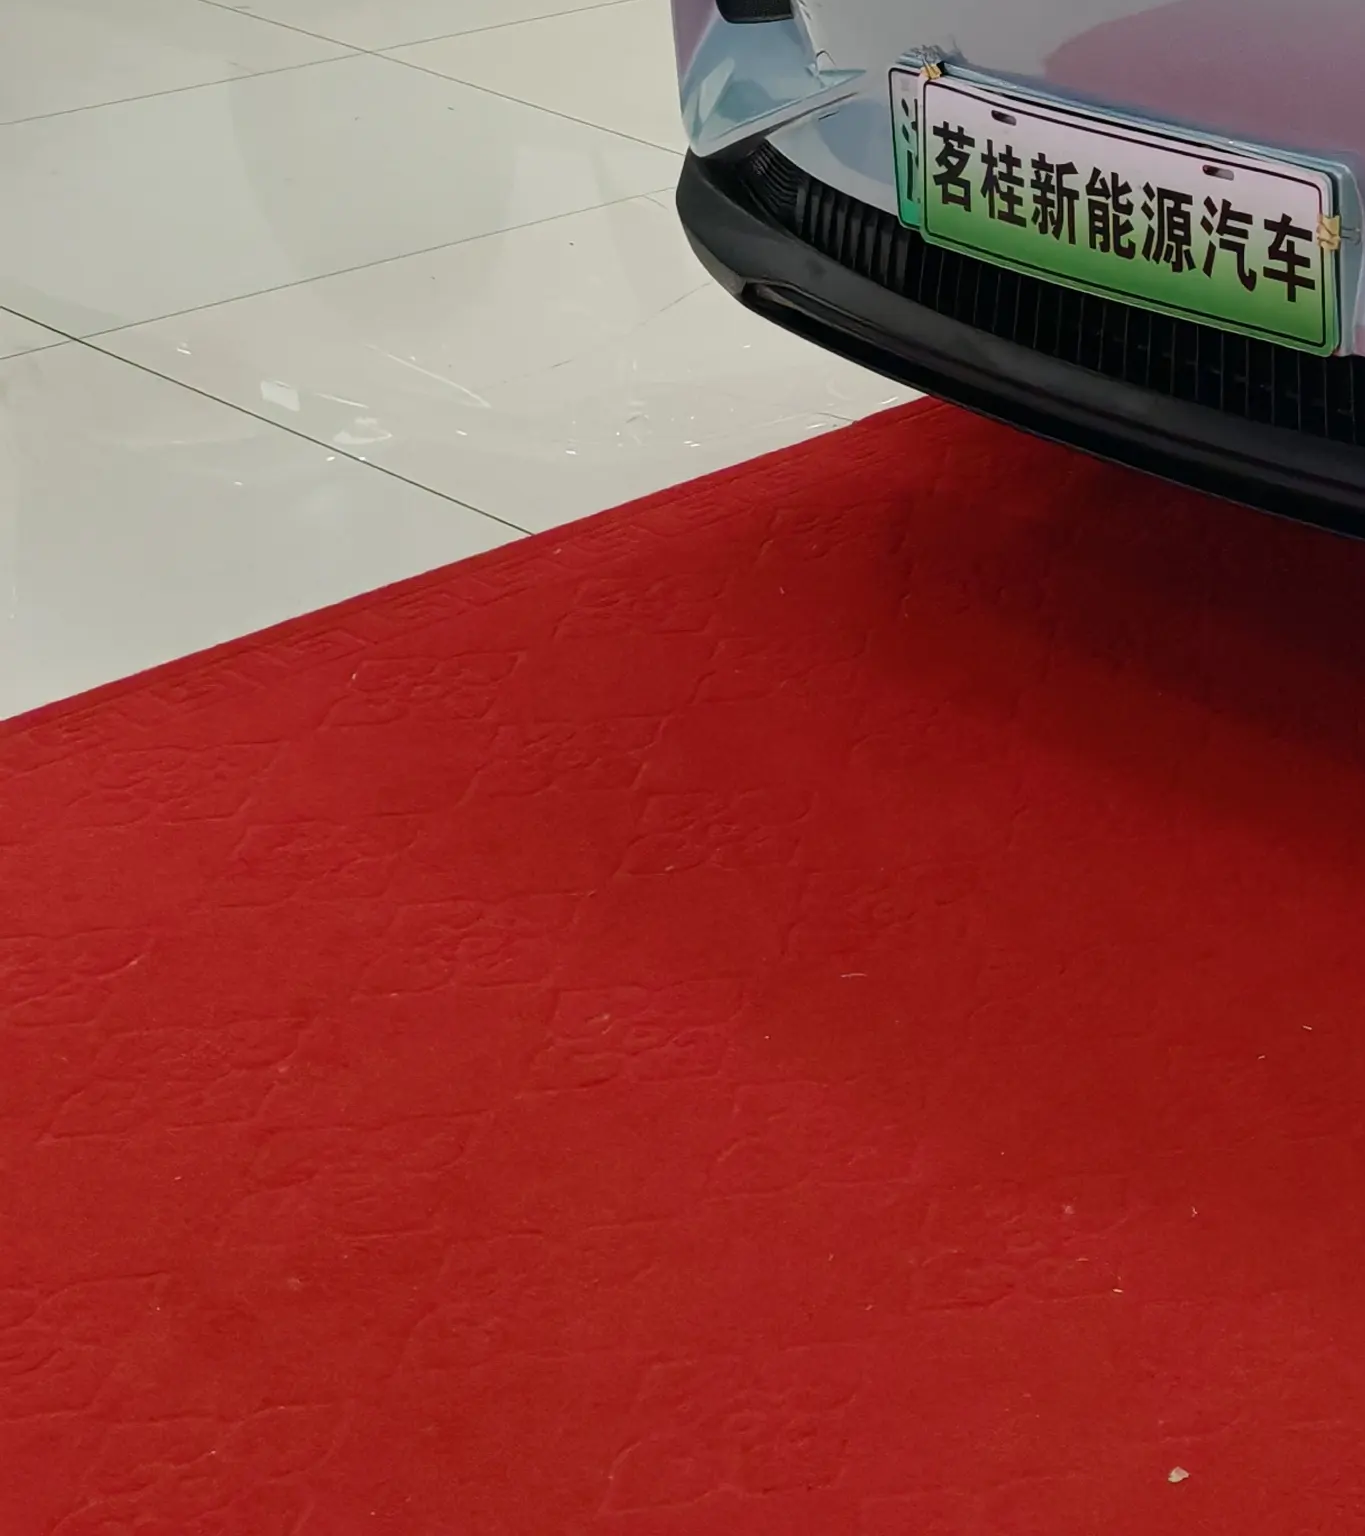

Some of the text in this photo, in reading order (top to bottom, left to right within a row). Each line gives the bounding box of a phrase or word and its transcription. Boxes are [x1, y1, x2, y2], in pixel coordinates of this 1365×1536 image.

[932, 120, 1317, 303] 茗桂新能源汽车
